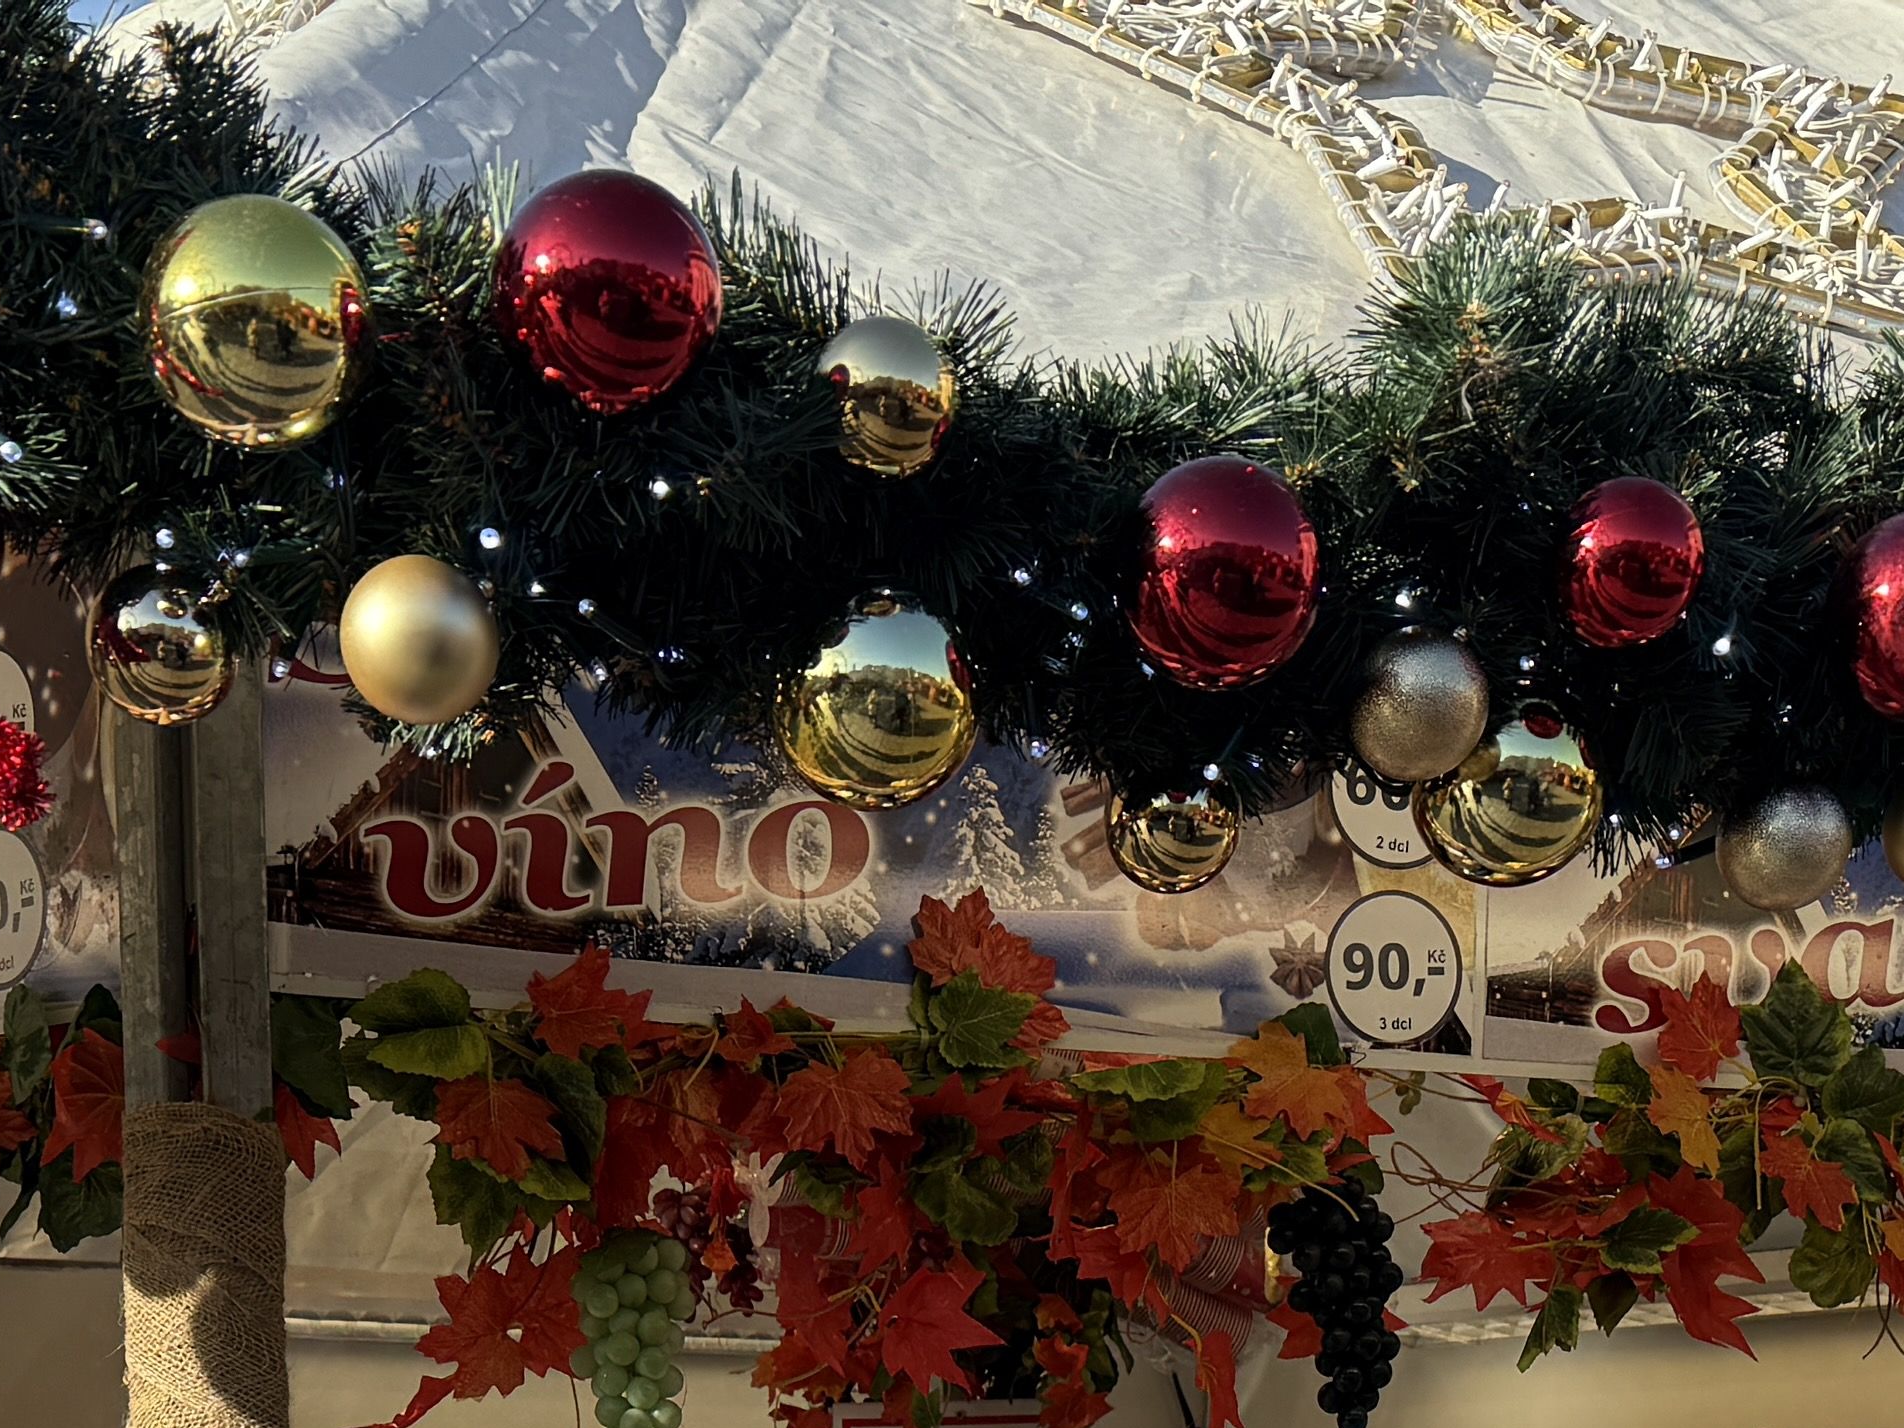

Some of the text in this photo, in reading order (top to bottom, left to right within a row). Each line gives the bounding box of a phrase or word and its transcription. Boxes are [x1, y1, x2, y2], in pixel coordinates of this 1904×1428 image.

[364, 761, 872, 918] víno
[1376, 836, 1409, 854] 2 dcl
[1343, 943, 1446, 997] 90,- Kč
[1379, 1017, 1412, 1031] 3 dcl
